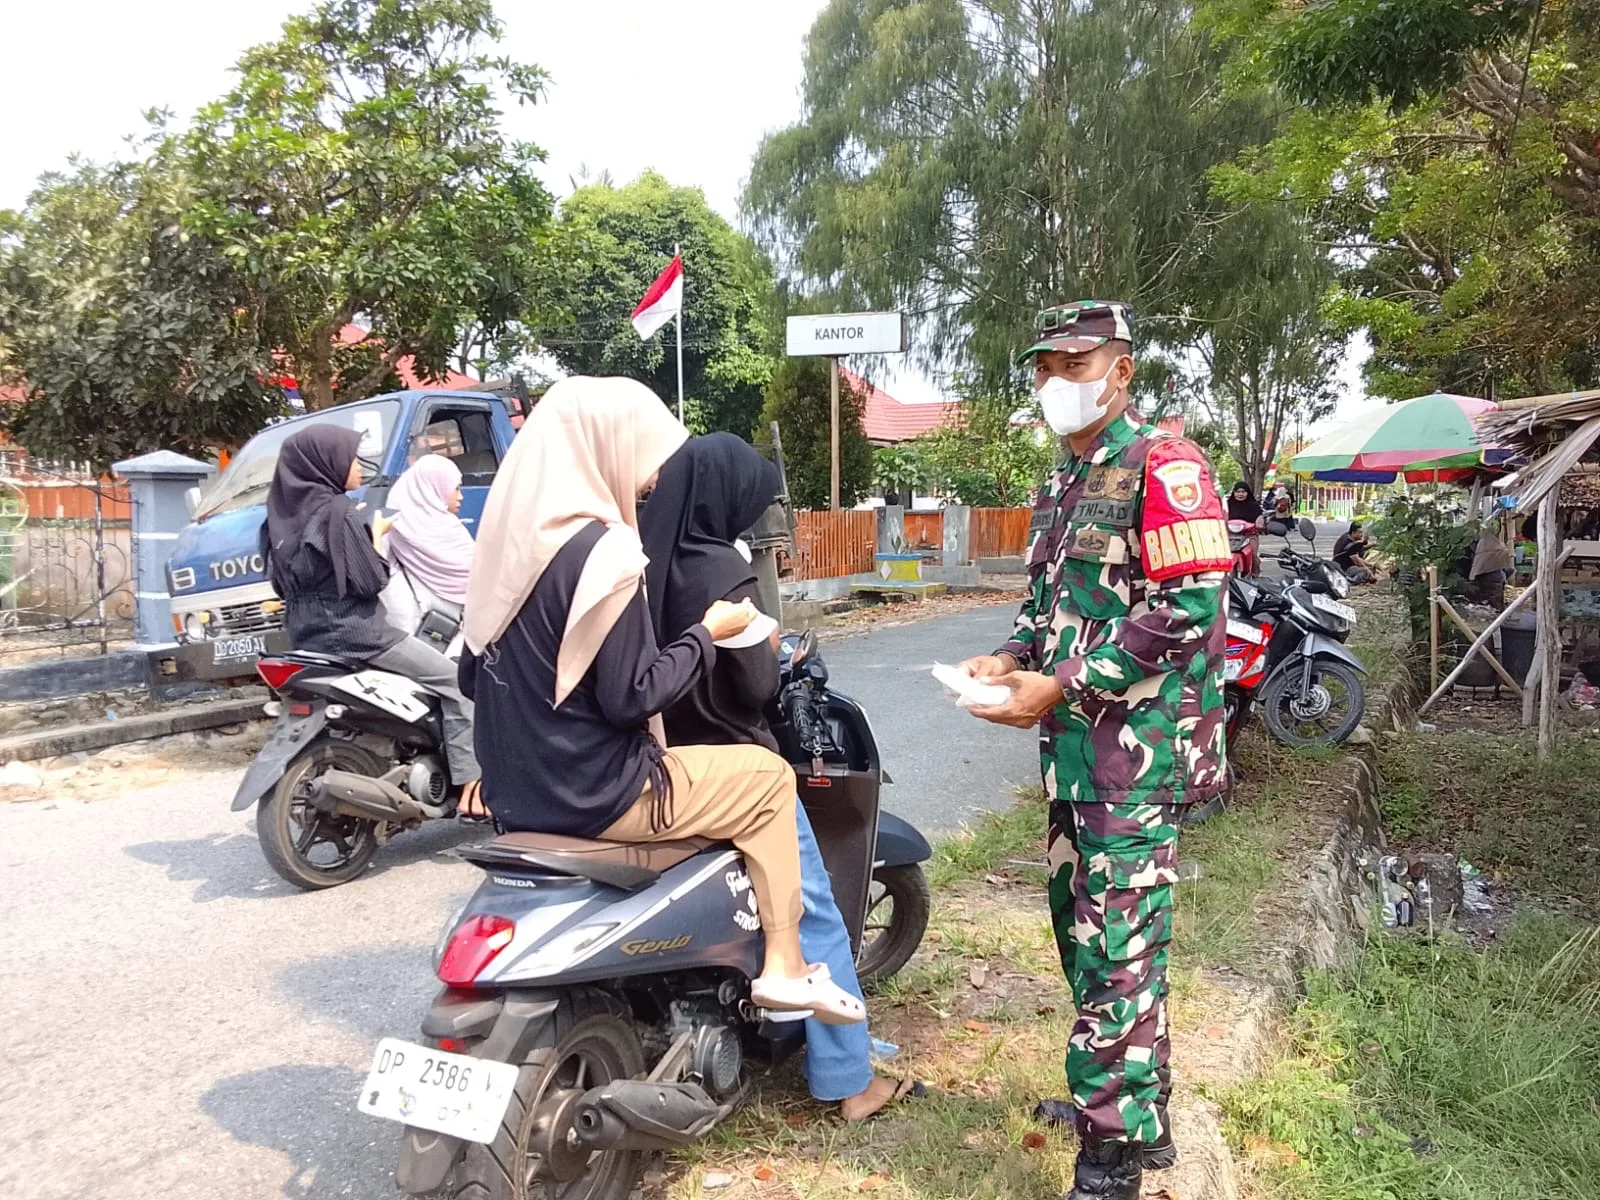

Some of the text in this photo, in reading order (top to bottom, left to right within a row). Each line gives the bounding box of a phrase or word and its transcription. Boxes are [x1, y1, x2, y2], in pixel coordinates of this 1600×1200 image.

[814, 326, 865, 341] KANTOR
[1078, 503, 1128, 521] TNI-AD
[209, 553, 265, 581] TOYO
[493, 876, 537, 888] HONDA
[620, 935, 693, 956] Genio
[378, 1049, 405, 1075] DP
[419, 1058, 472, 1093] 2586
